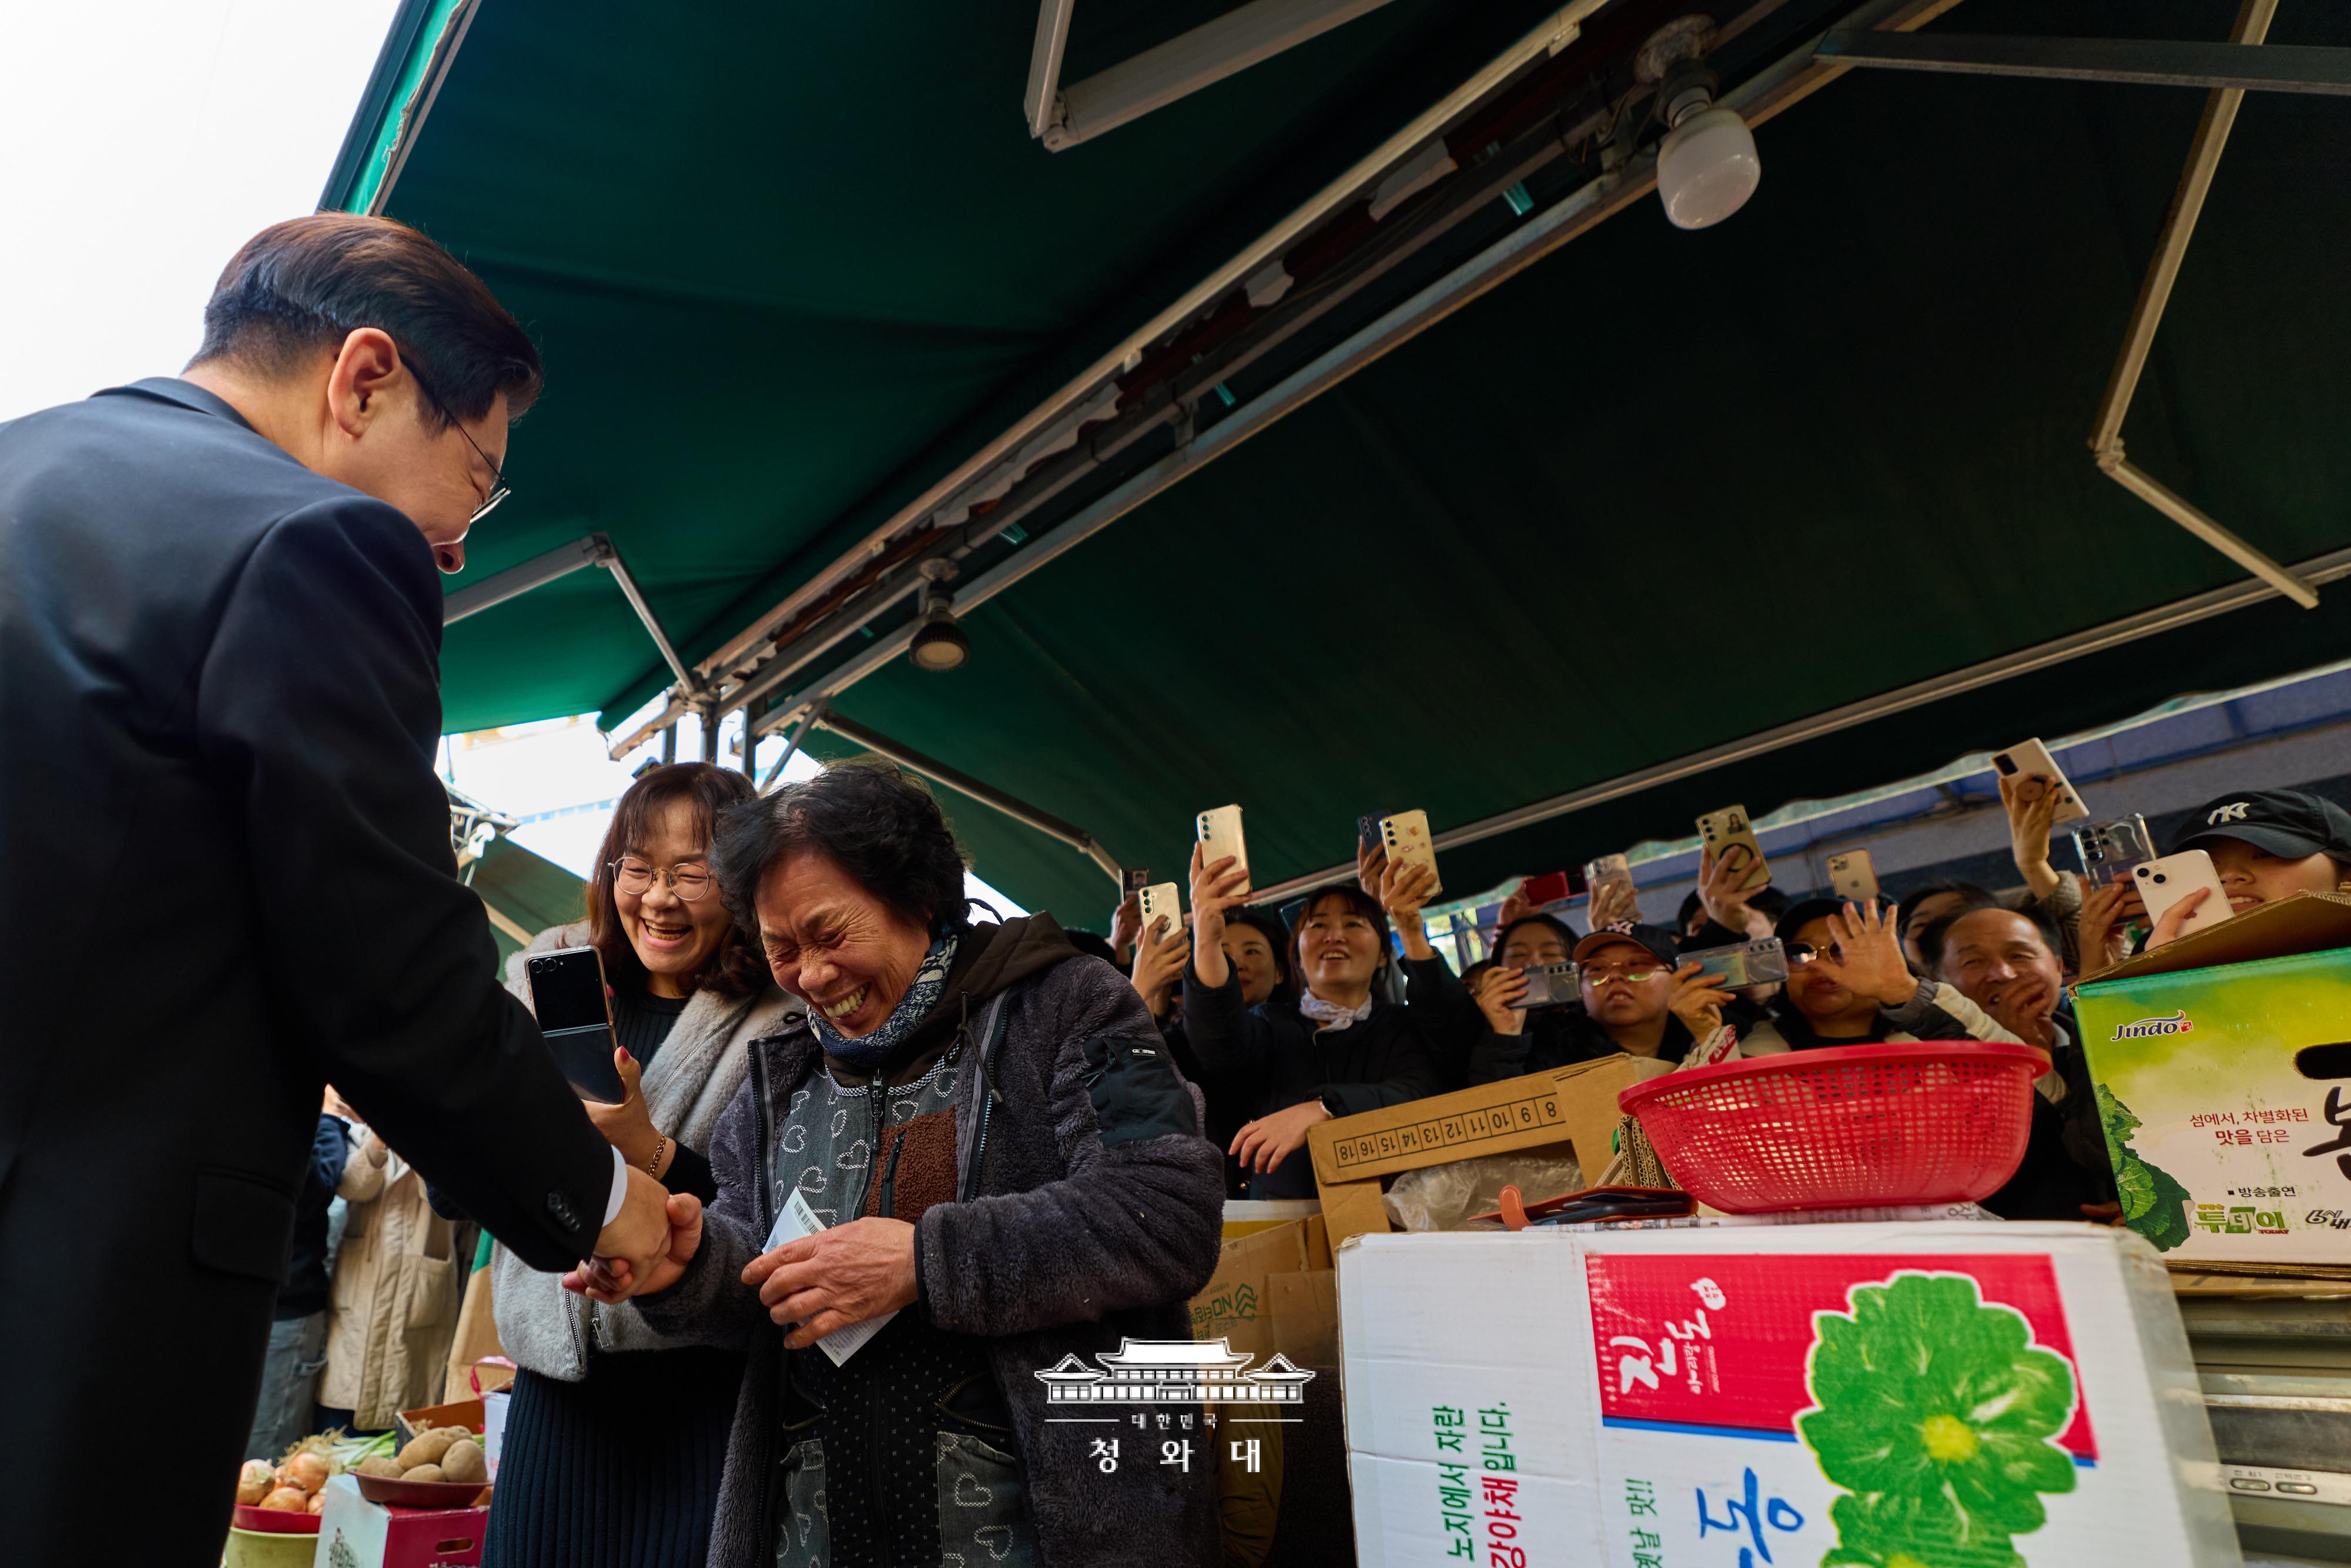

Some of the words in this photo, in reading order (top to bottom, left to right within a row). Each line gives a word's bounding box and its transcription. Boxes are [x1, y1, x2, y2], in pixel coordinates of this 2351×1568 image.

[2111, 1022, 2178, 1041] Jindo
[1521, 1107, 1531, 1123] 9
[1546, 1101, 1557, 1117] 8
[1469, 1117, 1485, 1134] 11
[1492, 1112, 1509, 1128] 10
[2190, 1112, 2239, 1128] 섬에서,
[2242, 1108, 2309, 1124] 차별화된
[1424, 1127, 1439, 1143] 13
[1445, 1122, 1462, 1138] 12
[2215, 1129, 2253, 1146] 맛을
[2256, 1130, 2290, 1144] 담은
[1381, 1137, 1396, 1151] 15
[1402, 1131, 1417, 1147] 14
[1339, 1145, 1355, 1161] 18
[1361, 1141, 1375, 1156] 16
[2238, 1187, 2296, 1198] 방송출연
[2194, 1207, 2286, 1234] 투데이
[1609, 1308, 1711, 1395] 진도
[1431, 1405, 1466, 1453] 자란
[1437, 1462, 1475, 1562] 노지에서
[1696, 1466, 1805, 1568] 동
